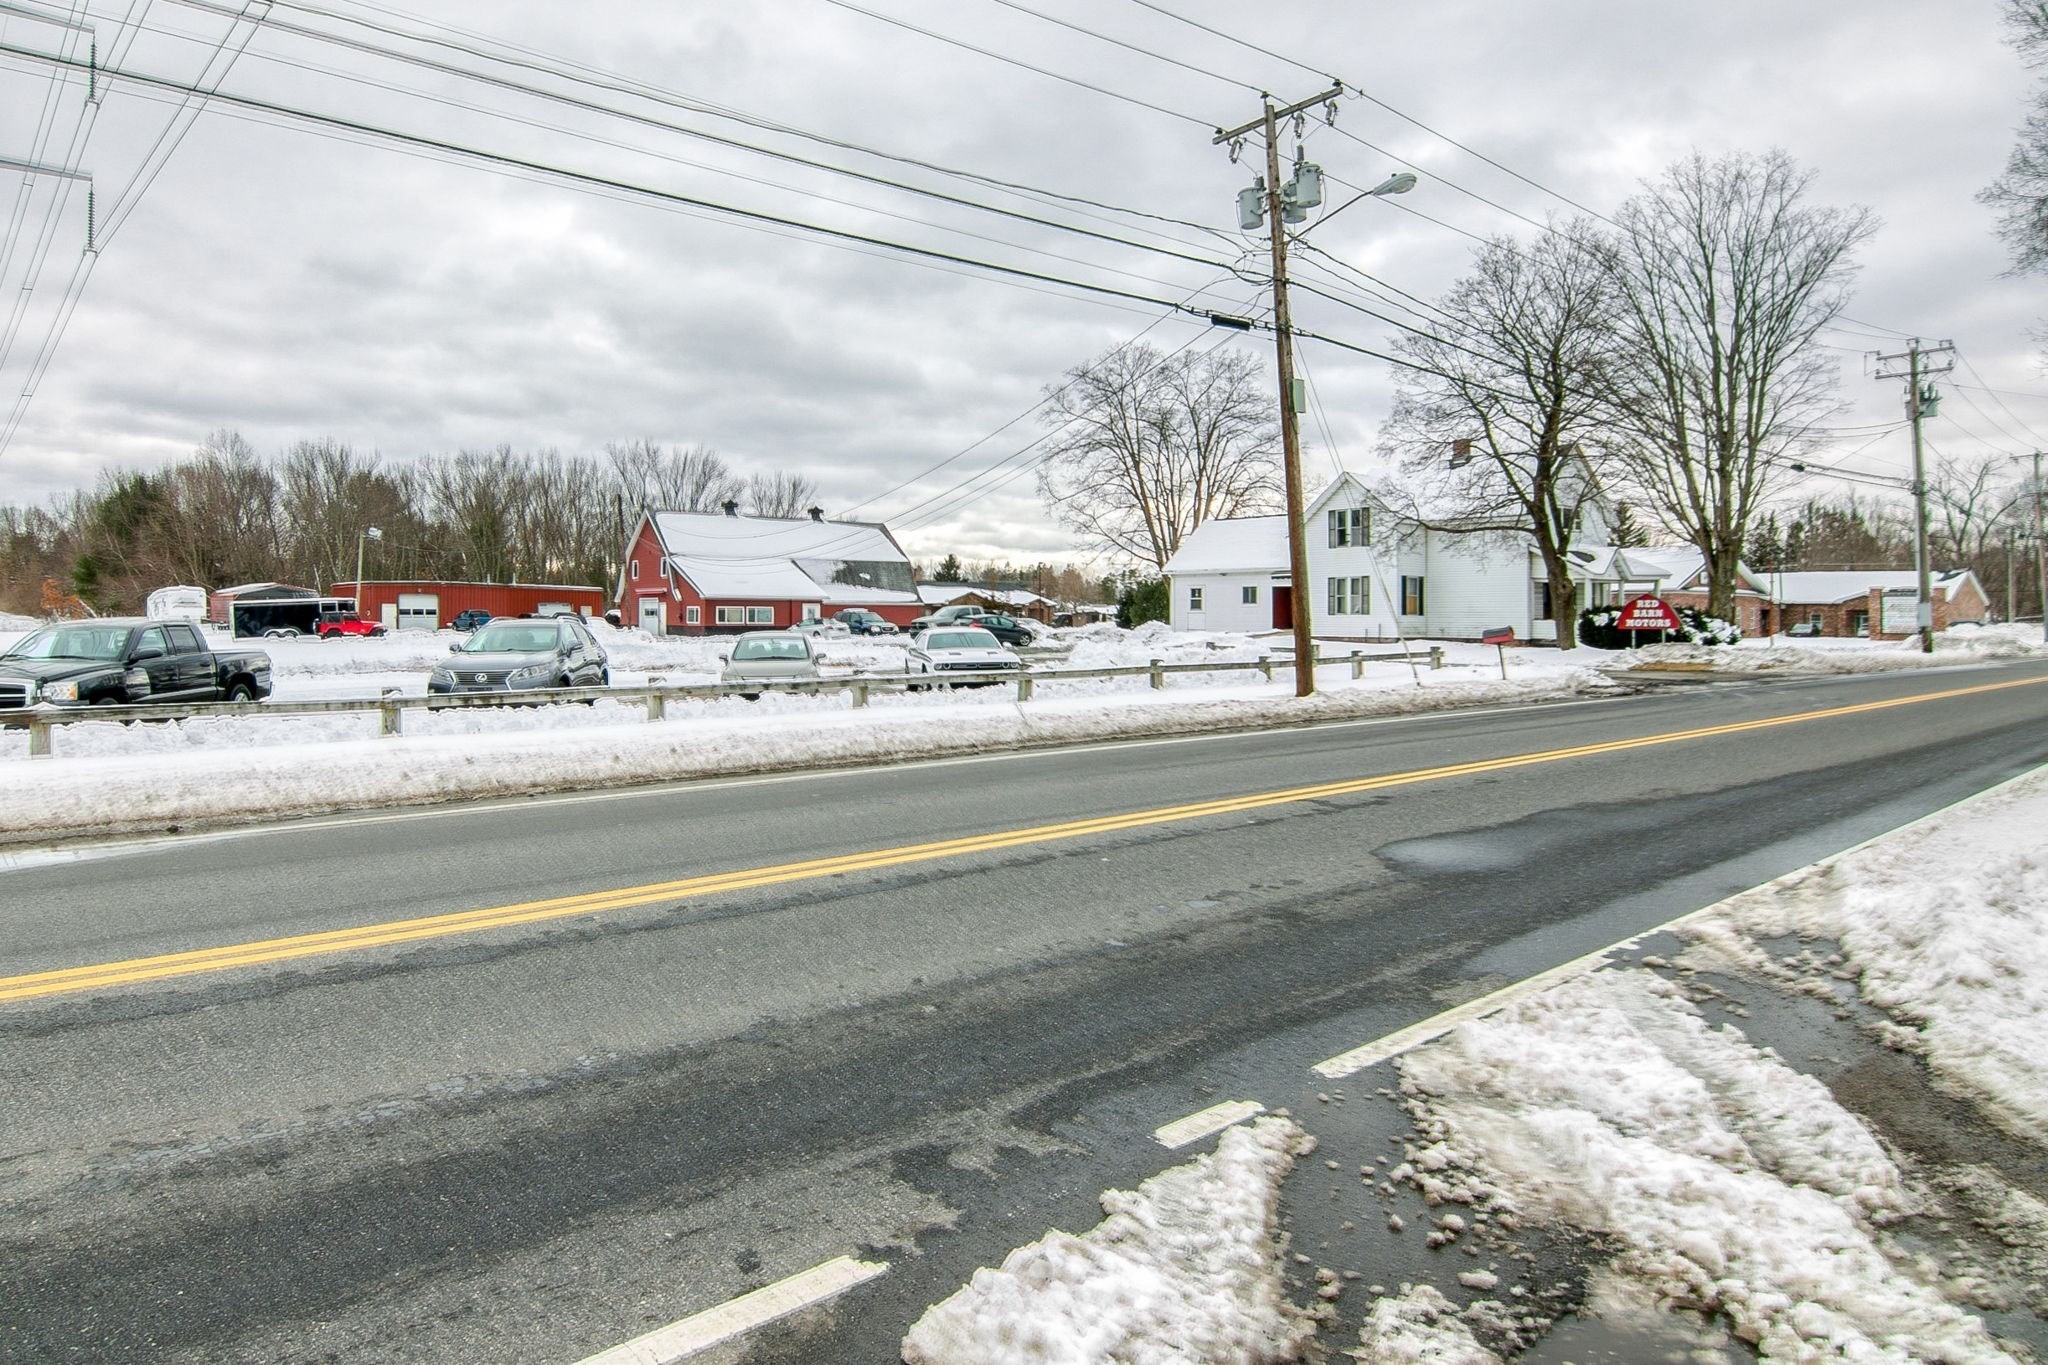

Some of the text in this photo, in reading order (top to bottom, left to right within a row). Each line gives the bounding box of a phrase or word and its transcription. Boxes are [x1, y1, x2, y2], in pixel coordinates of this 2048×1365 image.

[1636, 599, 1660, 608] RED
[1632, 609, 1664, 618] BARN
[1625, 618, 1672, 627] MOTORS
